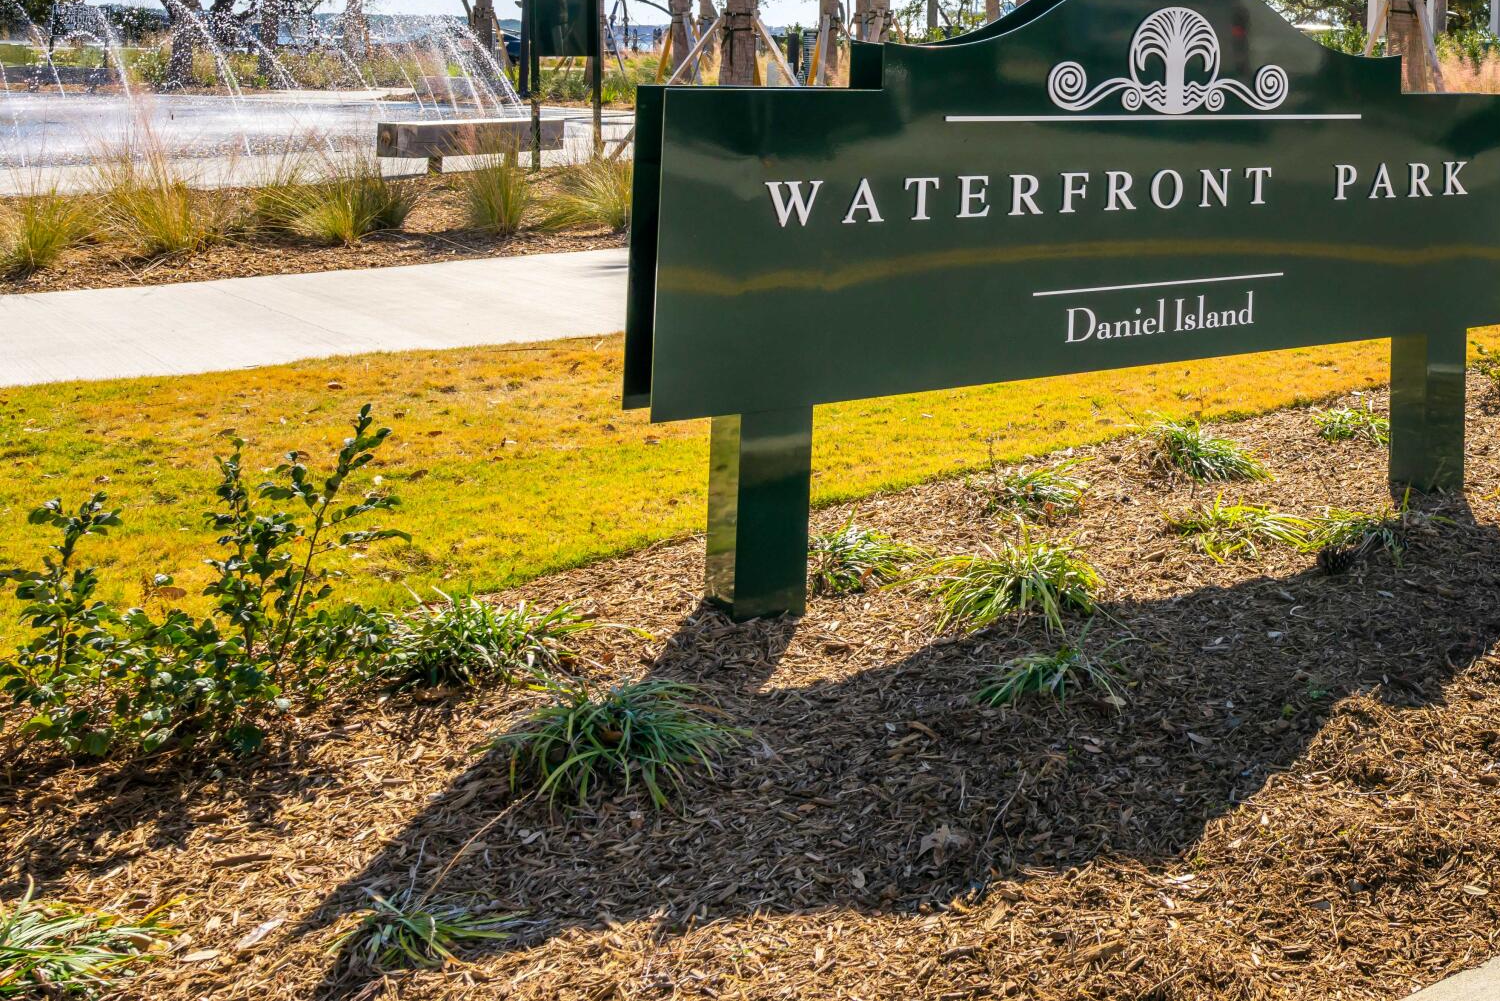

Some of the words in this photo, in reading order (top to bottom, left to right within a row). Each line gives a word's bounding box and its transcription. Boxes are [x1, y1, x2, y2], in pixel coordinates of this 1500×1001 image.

[764, 166, 1273, 228] WATERFRONT
[1331, 161, 1469, 201] PARK
[1064, 298, 1166, 344] Daniel
[1173, 290, 1255, 332] Island
